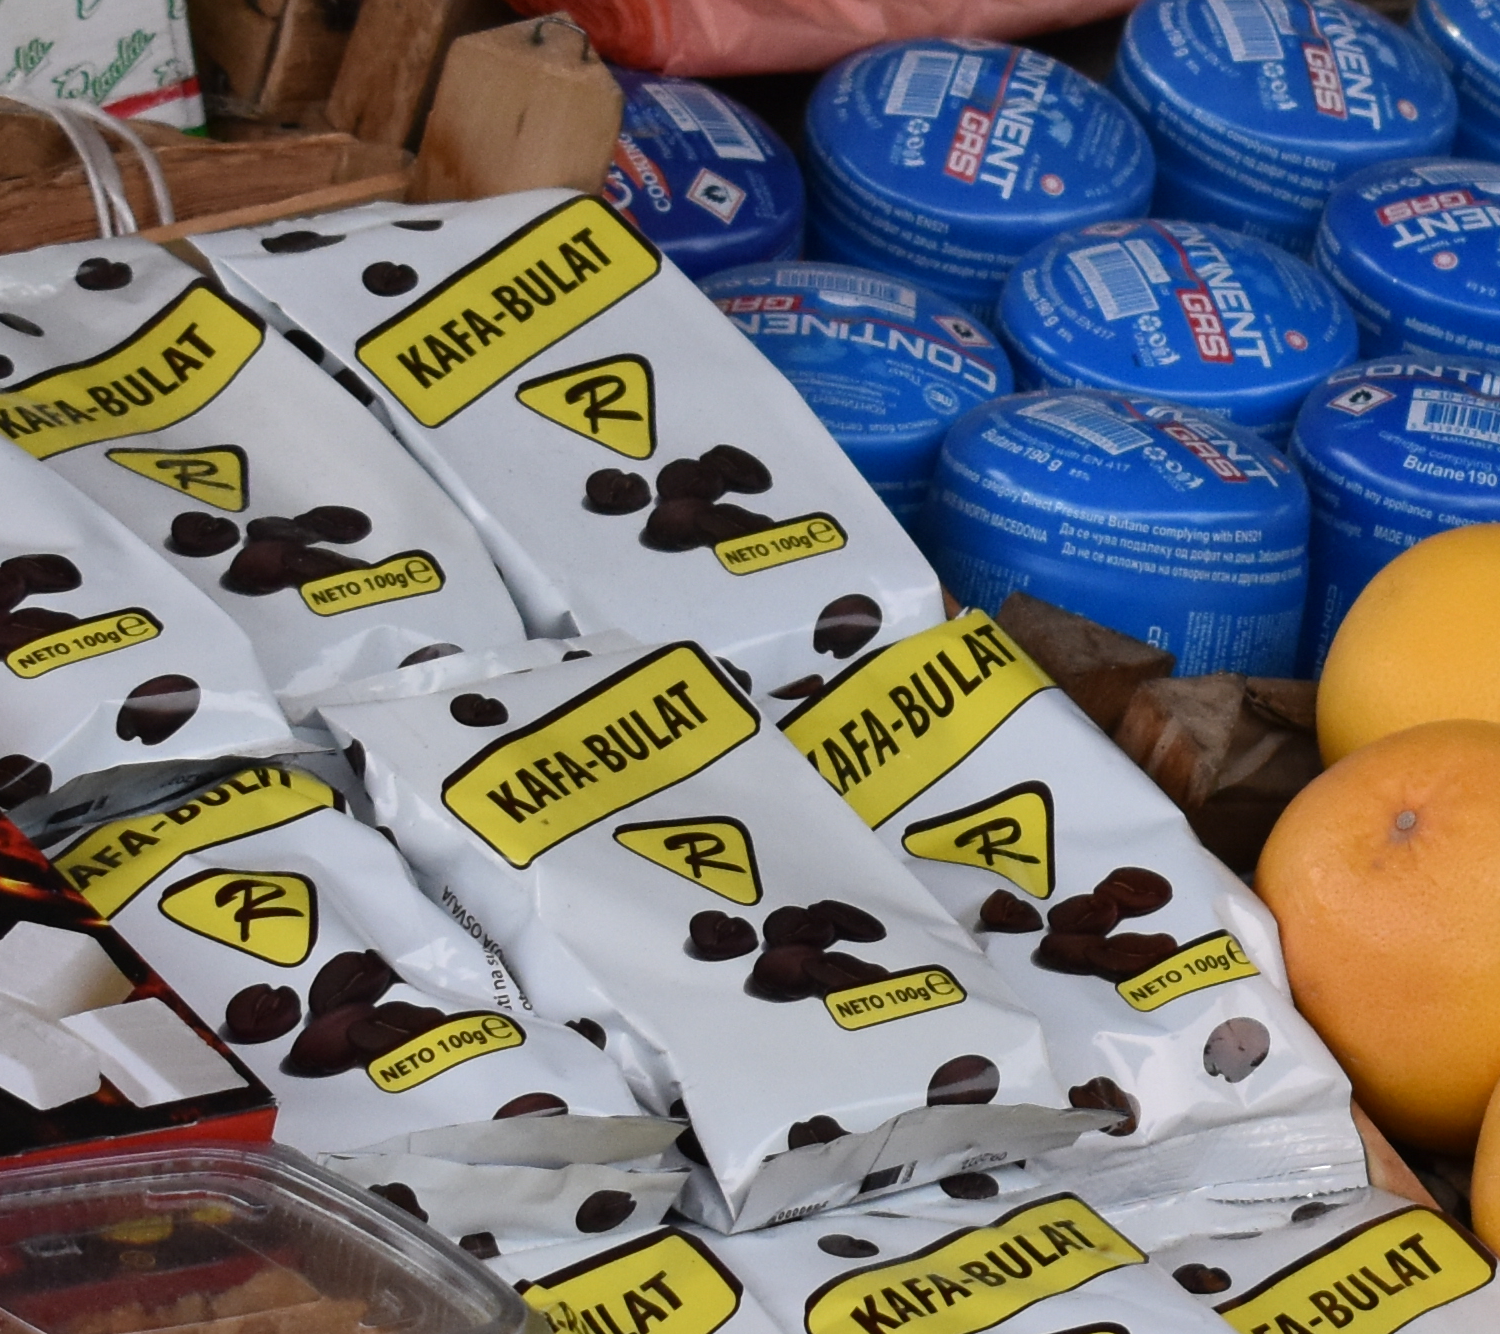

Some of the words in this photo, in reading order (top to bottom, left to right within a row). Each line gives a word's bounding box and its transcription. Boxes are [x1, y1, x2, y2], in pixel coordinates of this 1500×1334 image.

[1305, 50, 1343, 116] GAS
[949, 111, 991, 179] GAS
[1382, 192, 1471, 221] GAS
[394, 226, 617, 391] KAFA-BULAT
[1182, 292, 1232, 359] GAS
[728, 313, 998, 394] CONTINEN
[562, 375, 648, 436] R
[981, 428, 1024, 456] Butane
[1024, 445, 1050, 465] 190
[1165, 425, 1242, 478] GAS
[1403, 455, 1466, 482] Butane
[1468, 470, 1498, 488] 190
[172, 455, 222, 495] R
[1021, 489, 1052, 511] Direct
[1054, 501, 1106, 525] Pressure
[1108, 516, 1150, 534] Butane
[1152, 525, 1210, 544] complying
[1212, 530, 1232, 543] with
[1234, 529, 1263, 543] EN521
[1058, 522, 1078, 536] Да
[1382, 494, 1434, 519] appliance
[724, 542, 770, 570] NETO
[770, 528, 812, 562] 100g
[1061, 541, 1080, 556] Да
[1373, 524, 1403, 545] MADE
[309, 583, 363, 611] NETO
[362, 565, 411, 596] 100g
[17, 642, 72, 672] NETO
[72, 626, 121, 661] 100g
[484, 681, 712, 825] KAFA-BULAT
[661, 829, 750, 883] R
[952, 817, 1041, 869] R
[213, 878, 306, 944] R
[442, 885, 483, 939] OSVAJA
[834, 993, 886, 1023] NETO
[884, 978, 934, 1014] 100g
[1127, 971, 1186, 1006] NETO
[1181, 944, 1233, 983] 100g
[376, 1045, 438, 1086] NETO
[434, 1024, 491, 1064] 100g
